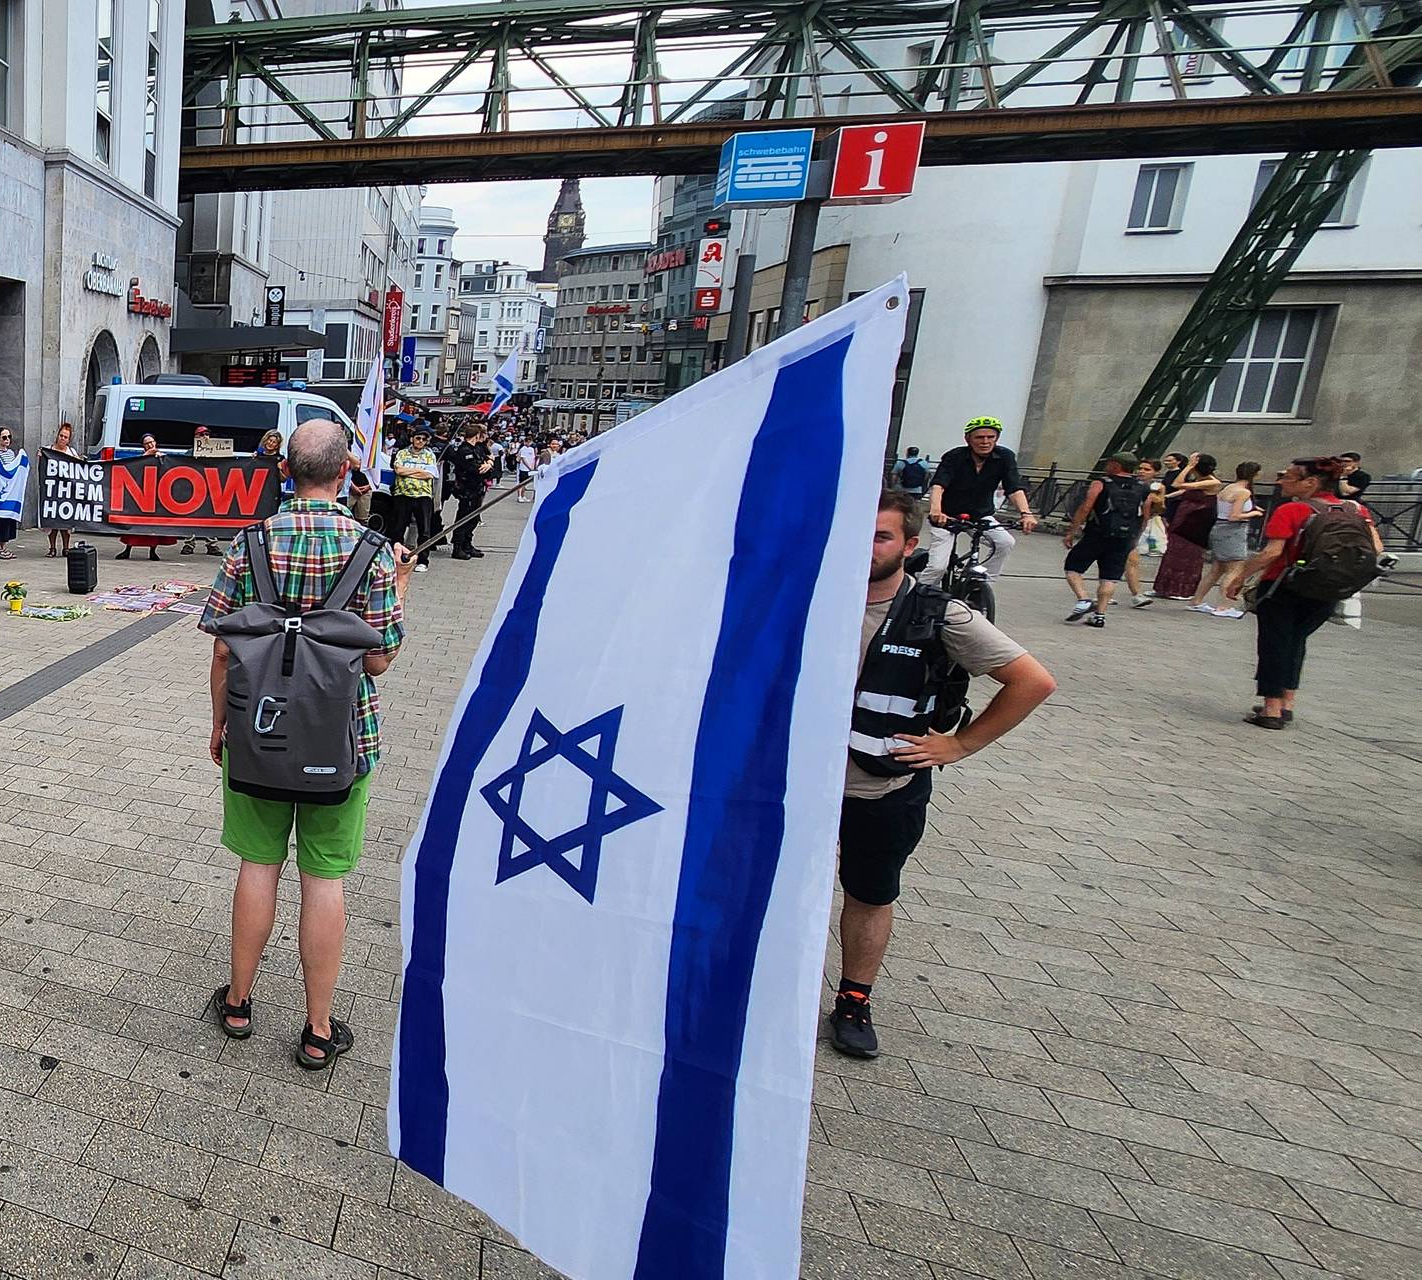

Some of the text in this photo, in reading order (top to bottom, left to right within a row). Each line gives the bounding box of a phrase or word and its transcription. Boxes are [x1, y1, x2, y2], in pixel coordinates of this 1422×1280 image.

[738, 146, 807, 157] schwebebahn
[386, 306, 397, 347] Studienkreis
[196, 440, 213, 453] Bring
[47, 459, 104, 482] BRING
[44, 480, 104, 502] THEM
[110, 465, 269, 516] NOW
[43, 501, 103, 522] HOME
[881, 644, 922, 658] PRESSE
